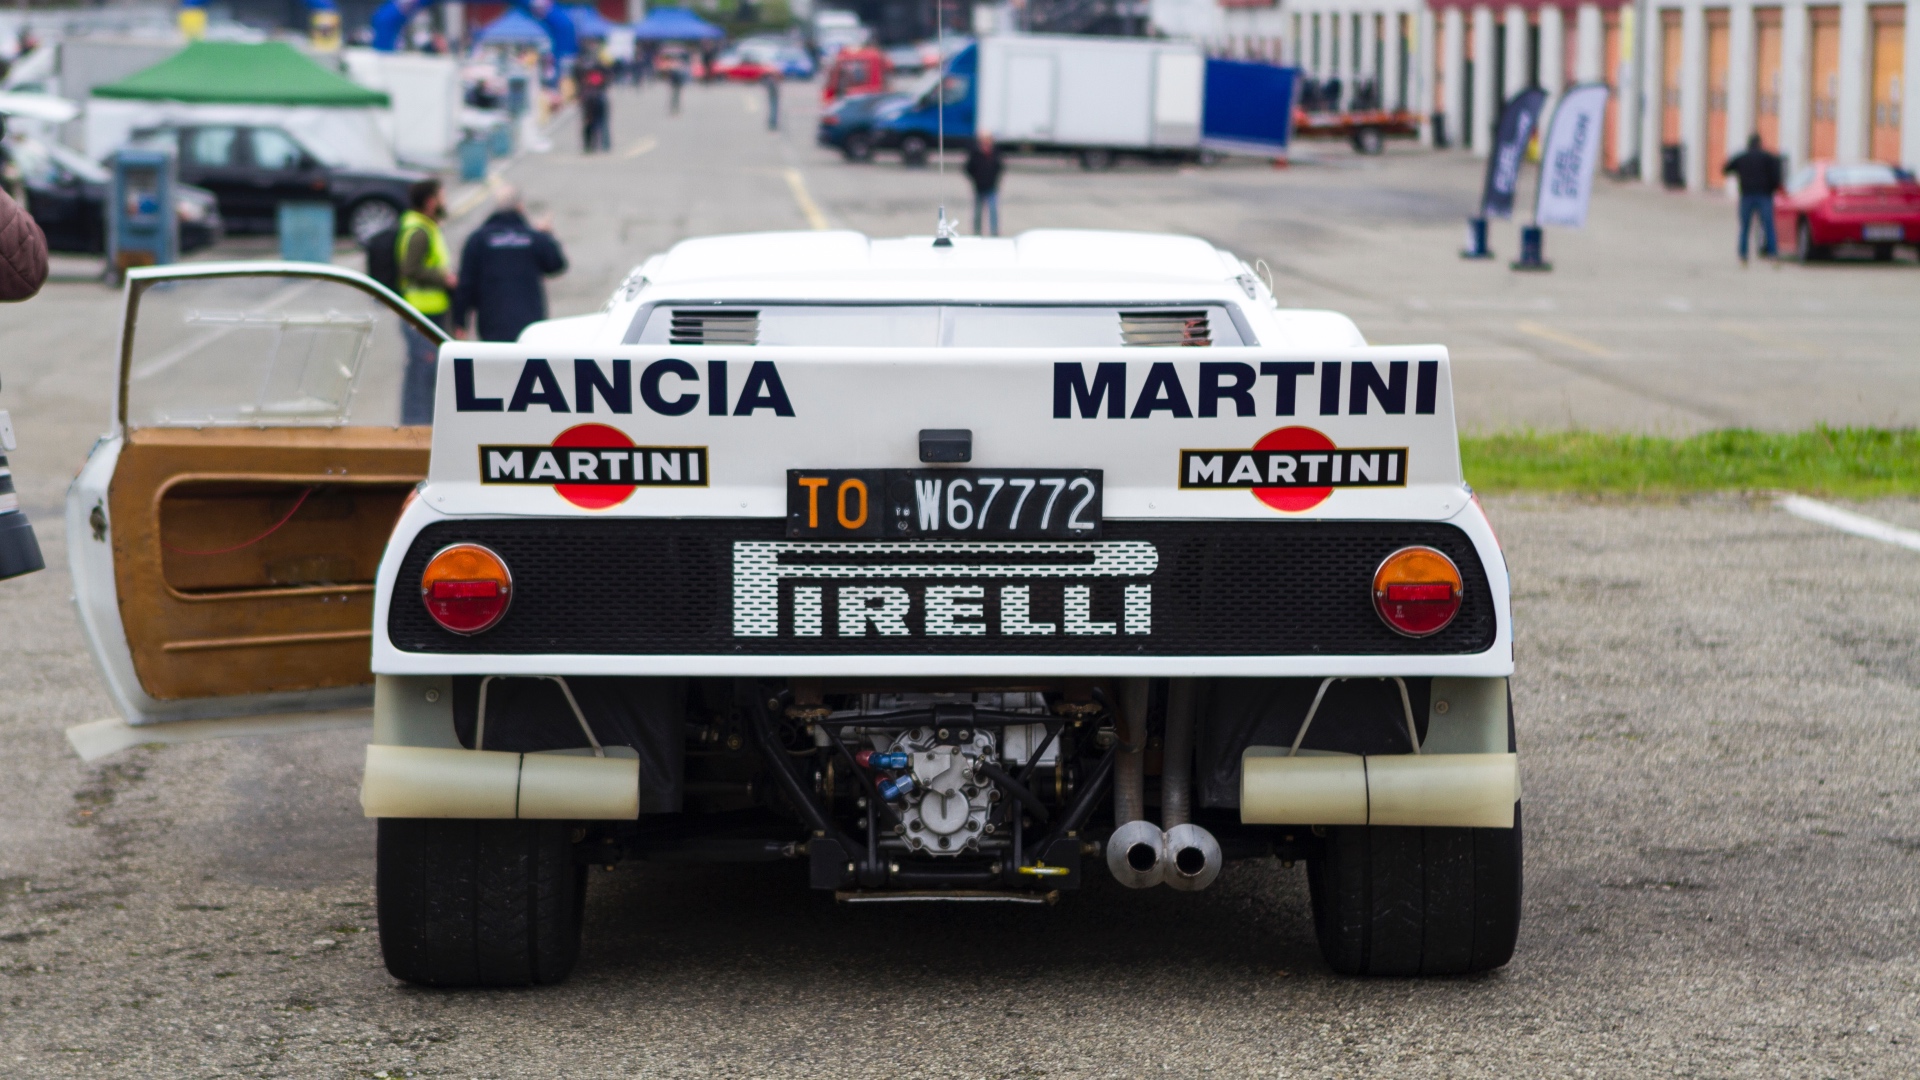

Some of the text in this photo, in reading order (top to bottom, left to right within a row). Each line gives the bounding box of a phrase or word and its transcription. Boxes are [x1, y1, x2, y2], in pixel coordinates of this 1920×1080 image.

[454, 358, 796, 417] LANCIA
[1053, 360, 1439, 420] MARTINI
[488, 450, 700, 482] MARTINI
[1187, 453, 1399, 484] MARTINI
[798, 477, 1096, 531] TO W67772
[733, 540, 1159, 638] PIRELLI
